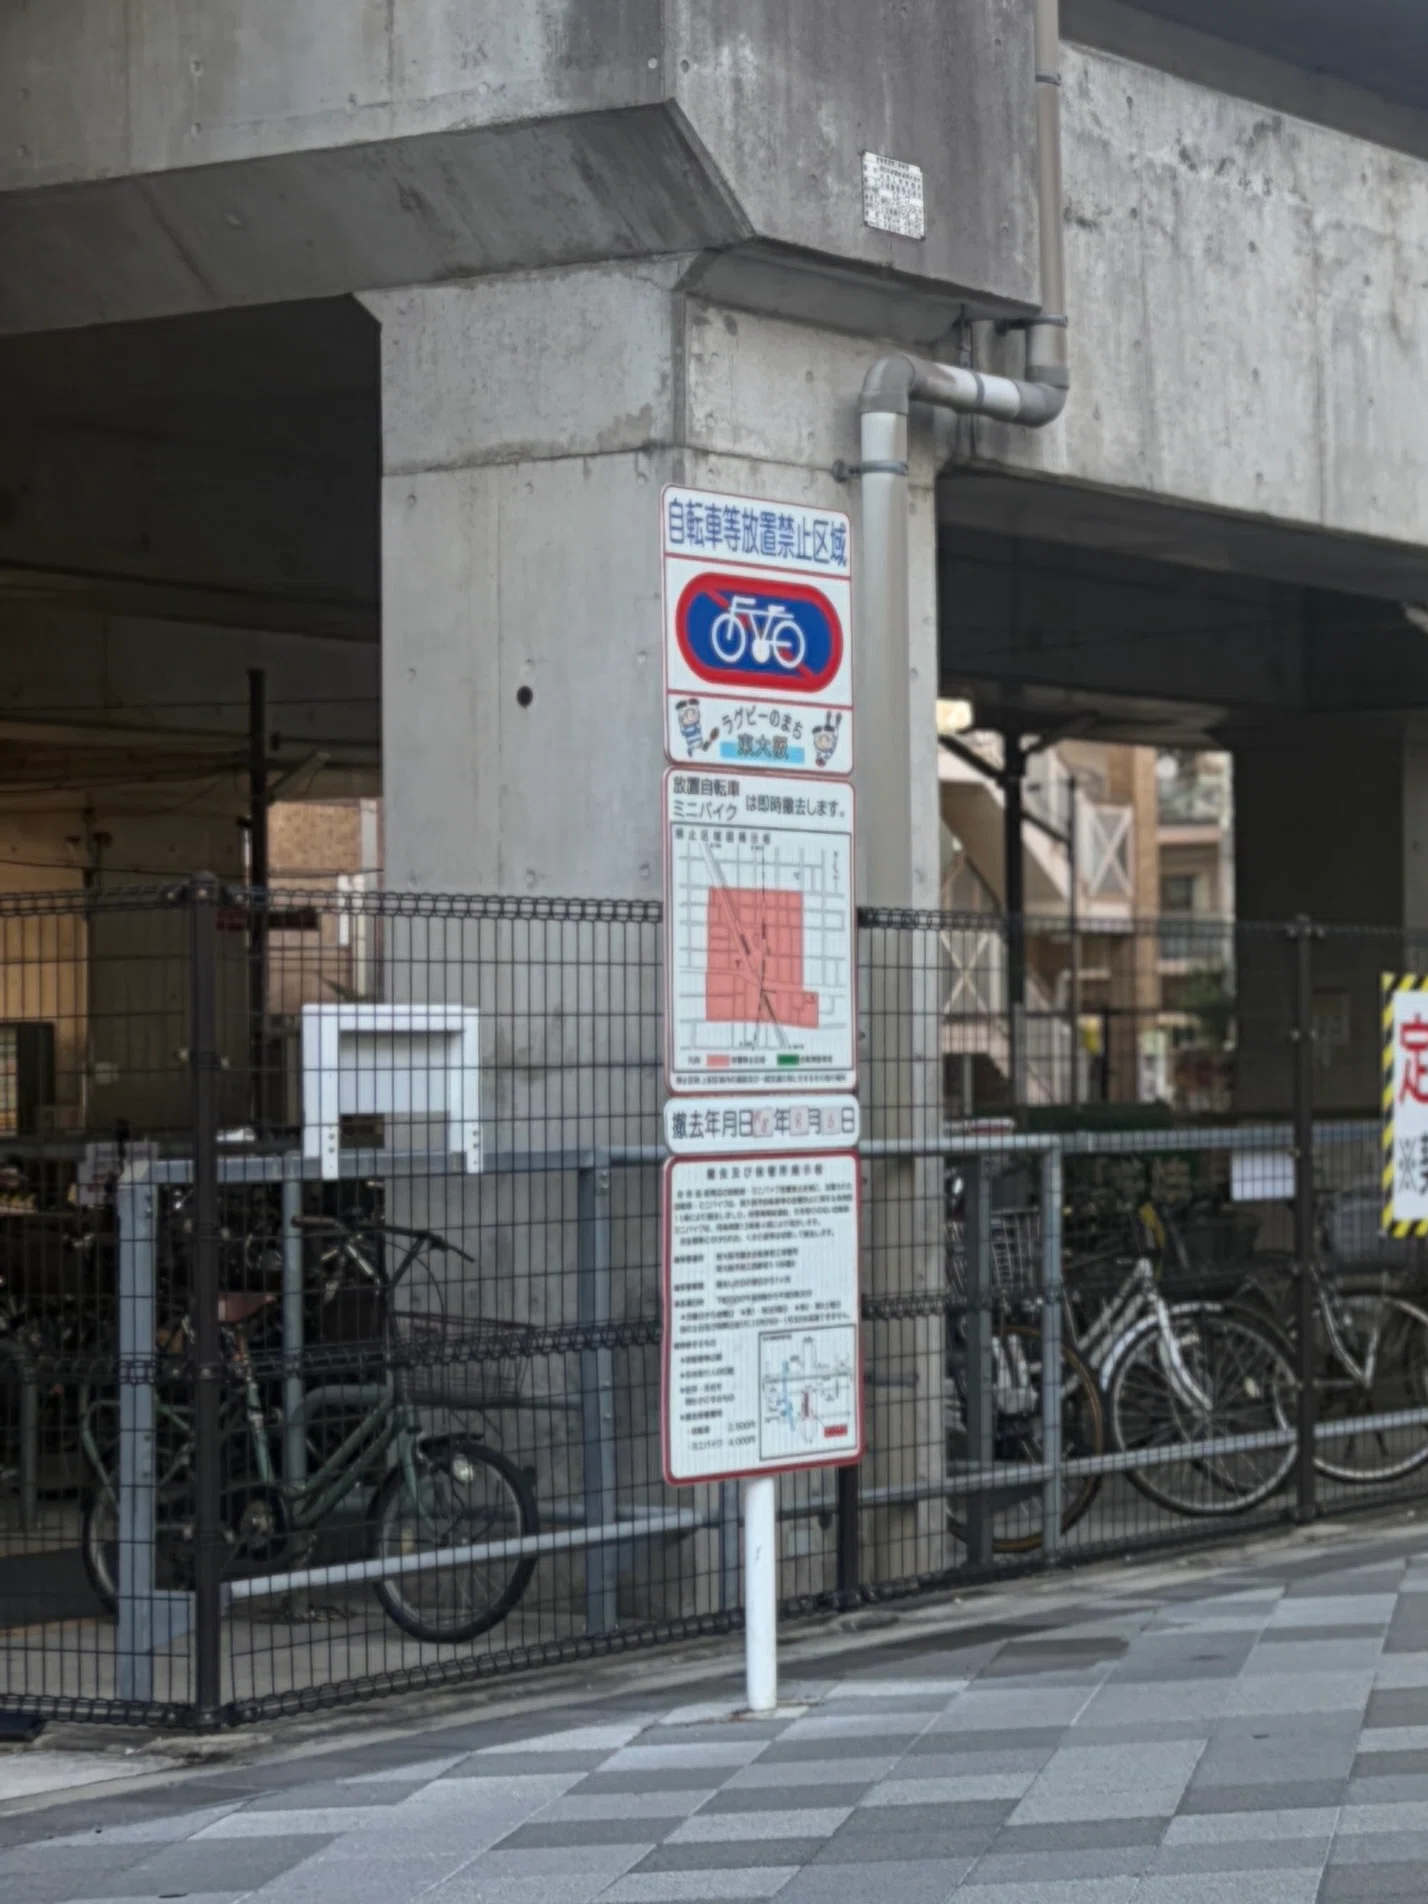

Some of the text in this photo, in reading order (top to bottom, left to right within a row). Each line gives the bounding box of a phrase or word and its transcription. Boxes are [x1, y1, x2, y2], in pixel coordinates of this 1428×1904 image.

[668, 497, 848, 568] 自転車等放置禁止区域
[721, 705, 804, 740] ラグビーのまち
[672, 775, 741, 797] 放置自転車
[672, 799, 738, 821] ミニバイク
[745, 793, 846, 818] は即時撤去します。
